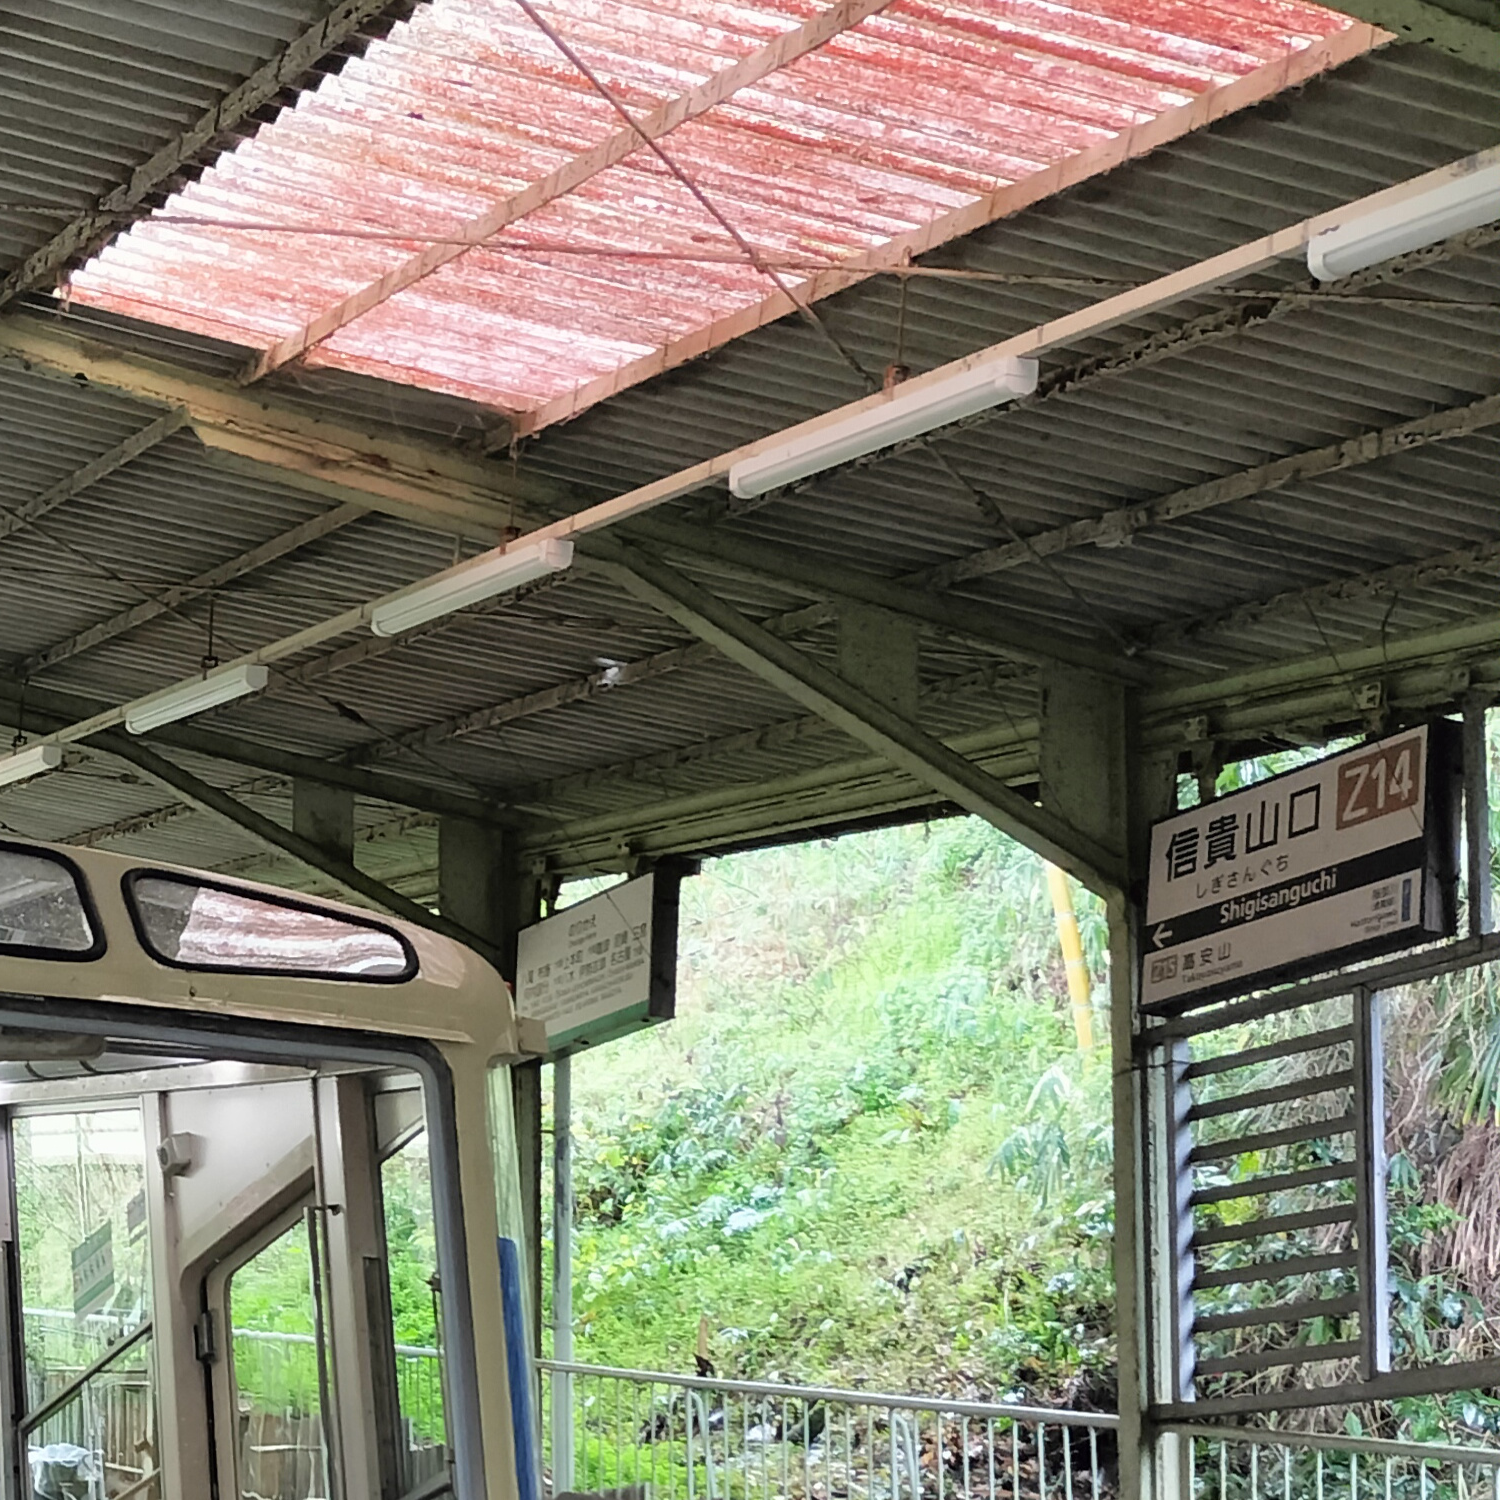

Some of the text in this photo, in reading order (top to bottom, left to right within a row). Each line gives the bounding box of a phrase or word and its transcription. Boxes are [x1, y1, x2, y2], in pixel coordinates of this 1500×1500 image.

[1342, 749, 1413, 822] Z14
[1165, 783, 1321, 883] 信貴山口
[1195, 854, 1290, 899] しぎさんぐち
[1219, 868, 1338, 925] Shigisanguchi
